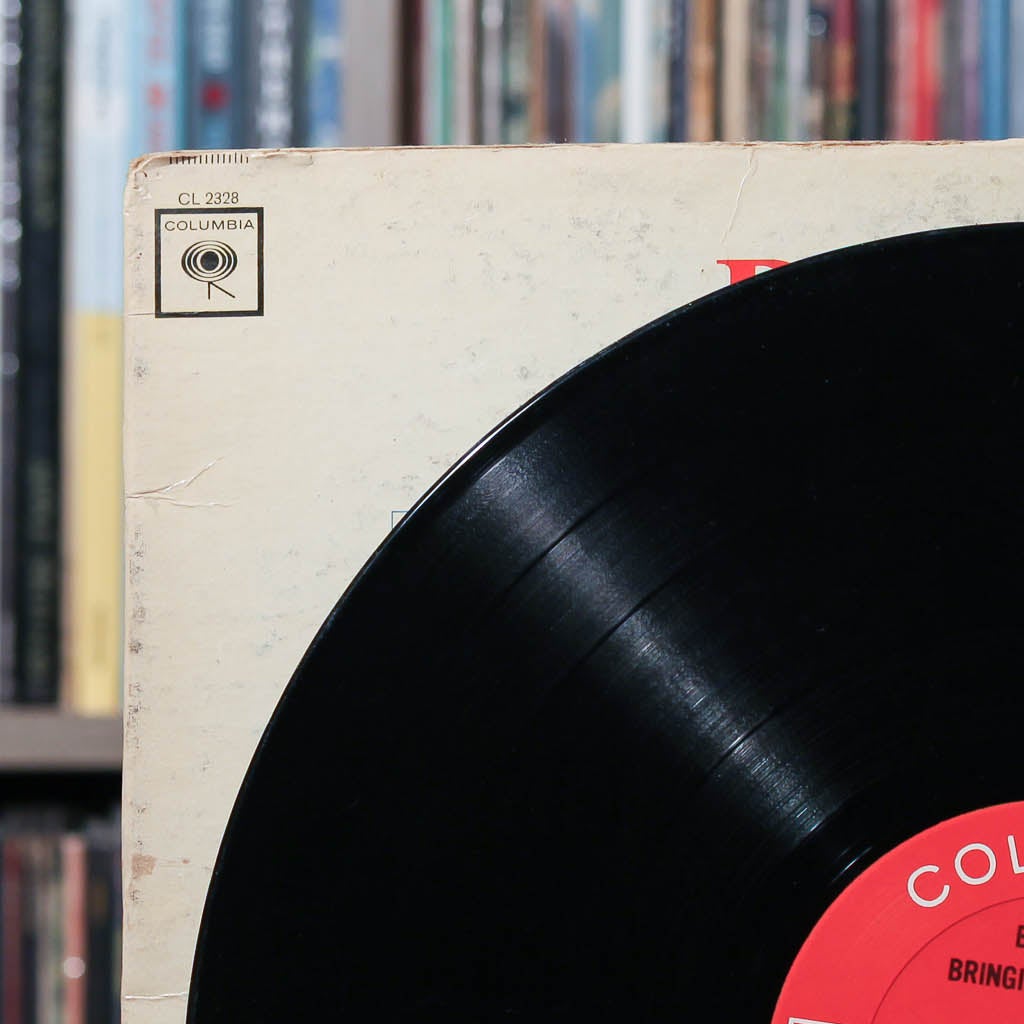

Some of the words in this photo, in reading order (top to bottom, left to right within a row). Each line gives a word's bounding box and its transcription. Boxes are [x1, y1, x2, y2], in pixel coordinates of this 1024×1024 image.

[178, 192, 200, 205] CL
[205, 191, 239, 205] 2328
[164, 219, 255, 231] COLUMBIA
